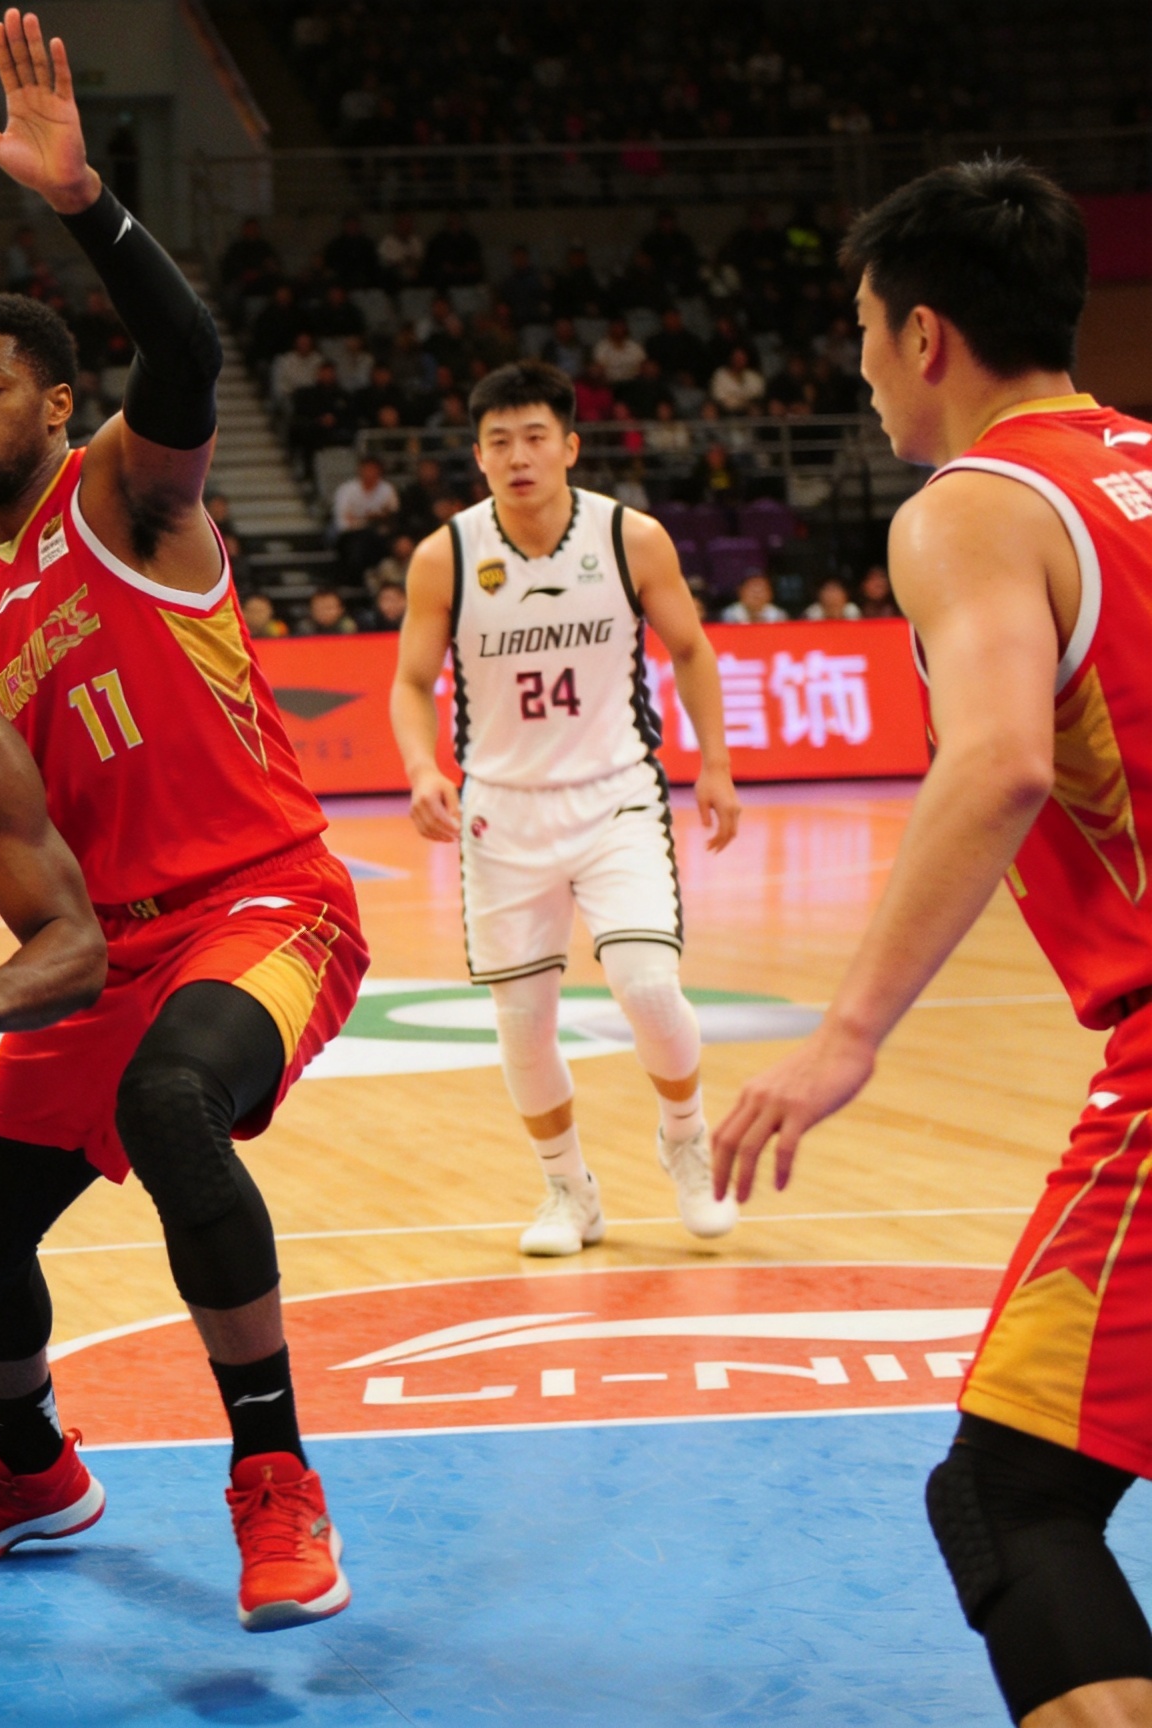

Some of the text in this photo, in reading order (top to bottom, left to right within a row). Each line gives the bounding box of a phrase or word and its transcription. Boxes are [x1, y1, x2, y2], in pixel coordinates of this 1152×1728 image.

[479, 617, 614, 658] LIAONING
[67, 668, 143, 762] 11
[516, 668, 580, 720] 24
